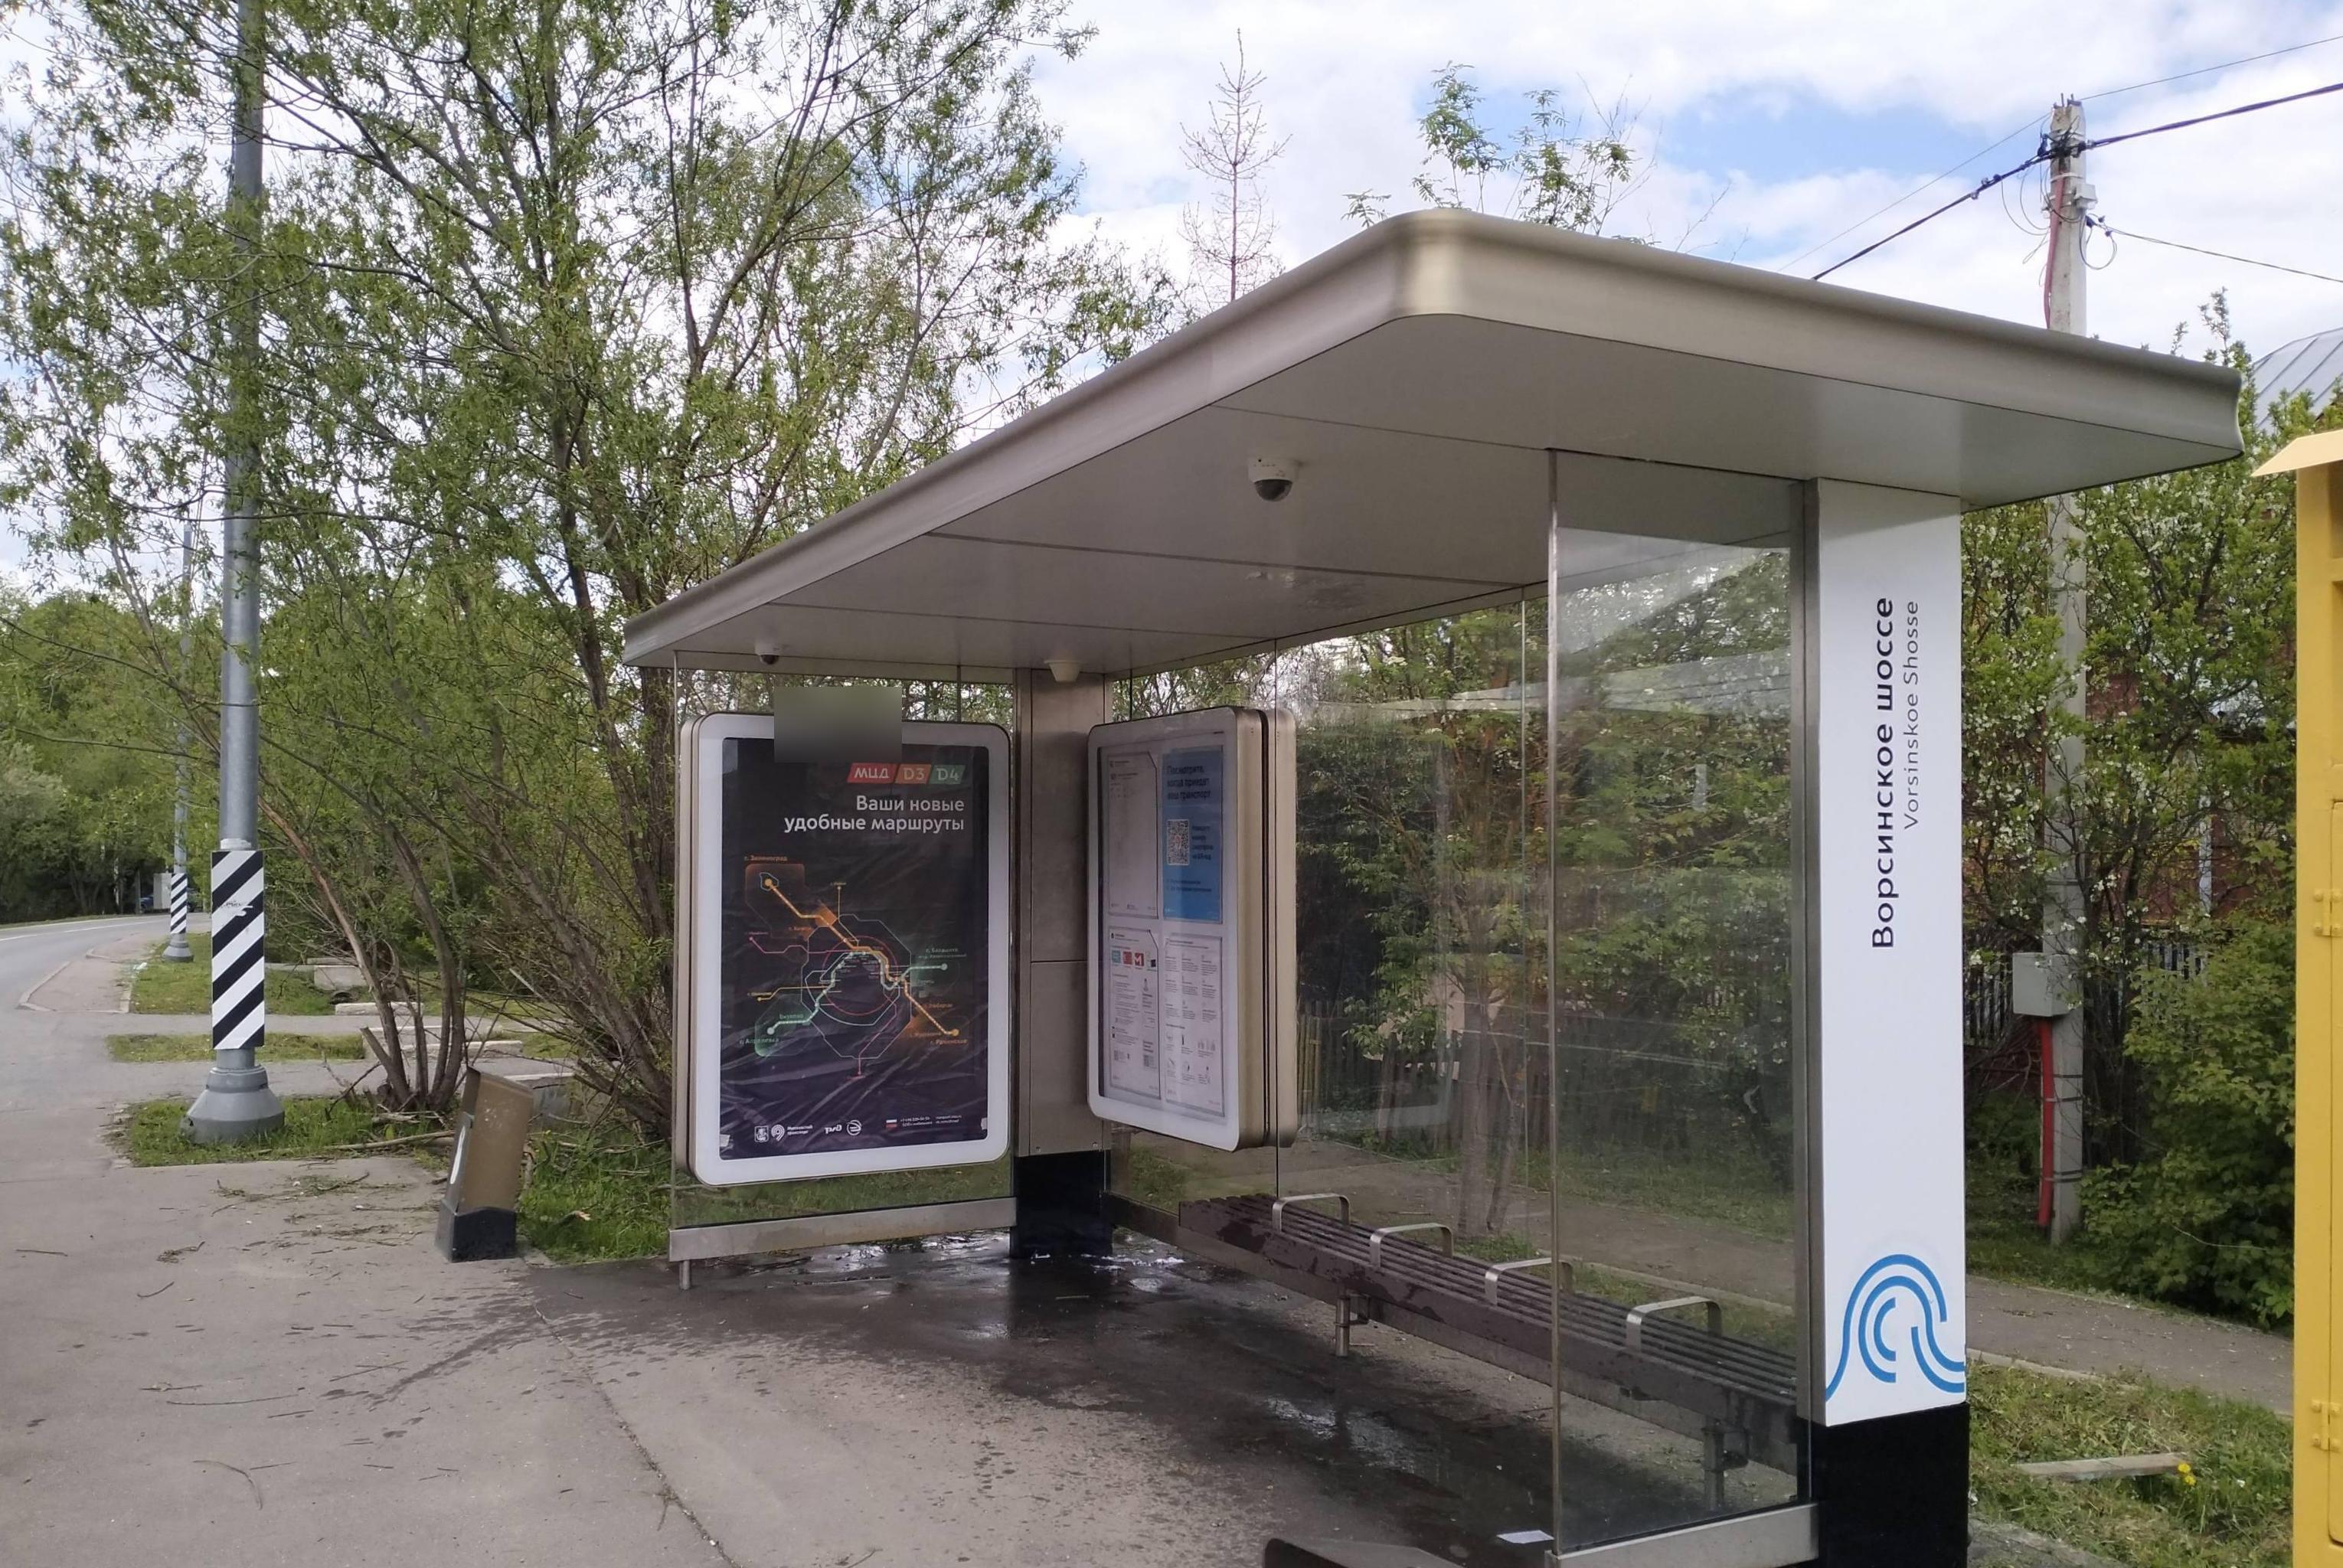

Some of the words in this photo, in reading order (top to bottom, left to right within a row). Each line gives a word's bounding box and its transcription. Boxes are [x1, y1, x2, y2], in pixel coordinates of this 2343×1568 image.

[1877, 598, 1893, 710] шоссе
[1903, 601, 1918, 685] Shosse
[854, 767, 890, 779] МЦД
[904, 768, 924, 780] D3
[937, 768, 959, 781] D4
[1903, 693, 1918, 829] Vorsinskoe
[784, 814, 866, 833] удобные
[871, 818, 965, 834] маршруты
[856, 795, 904, 812] Ваши
[910, 799, 965, 812] новые
[1872, 724, 1899, 948] Ворсинское
